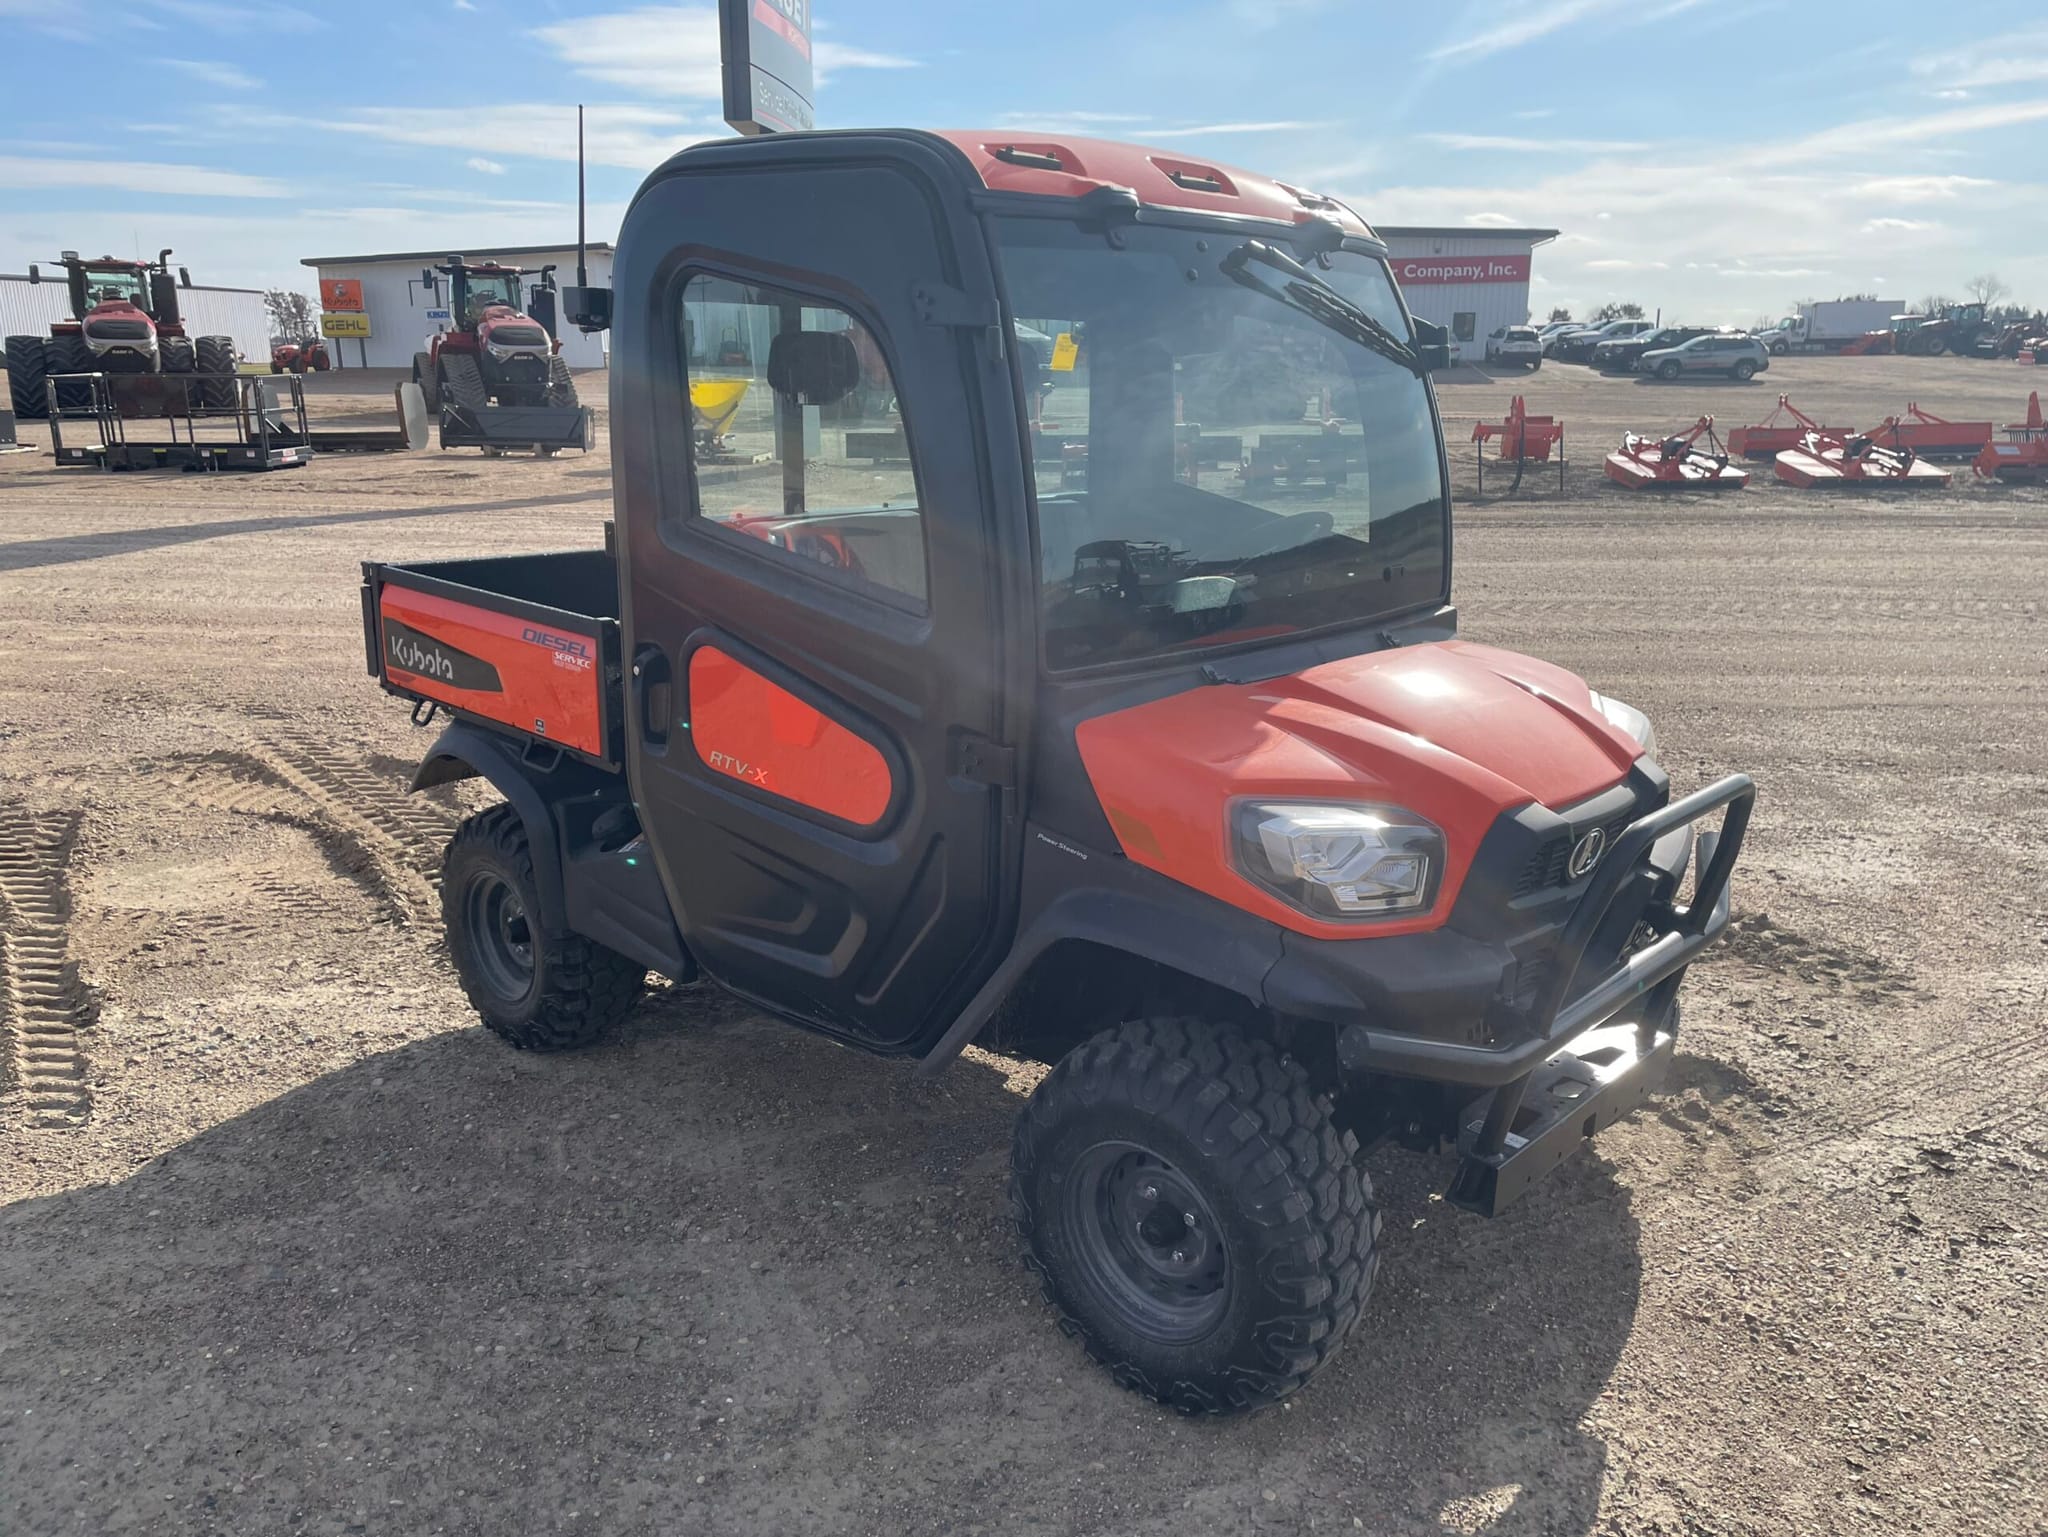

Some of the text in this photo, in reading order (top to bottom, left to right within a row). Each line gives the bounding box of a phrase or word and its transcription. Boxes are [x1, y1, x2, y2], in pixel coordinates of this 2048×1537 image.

[1404, 264, 1484, 280] Company,
[1488, 262, 1517, 276] Inc.
[324, 320, 367, 331] GEHL
[391, 635, 454, 680] Kubota
[523, 628, 593, 660] DIESEL
[709, 750, 769, 785] RTV-X
